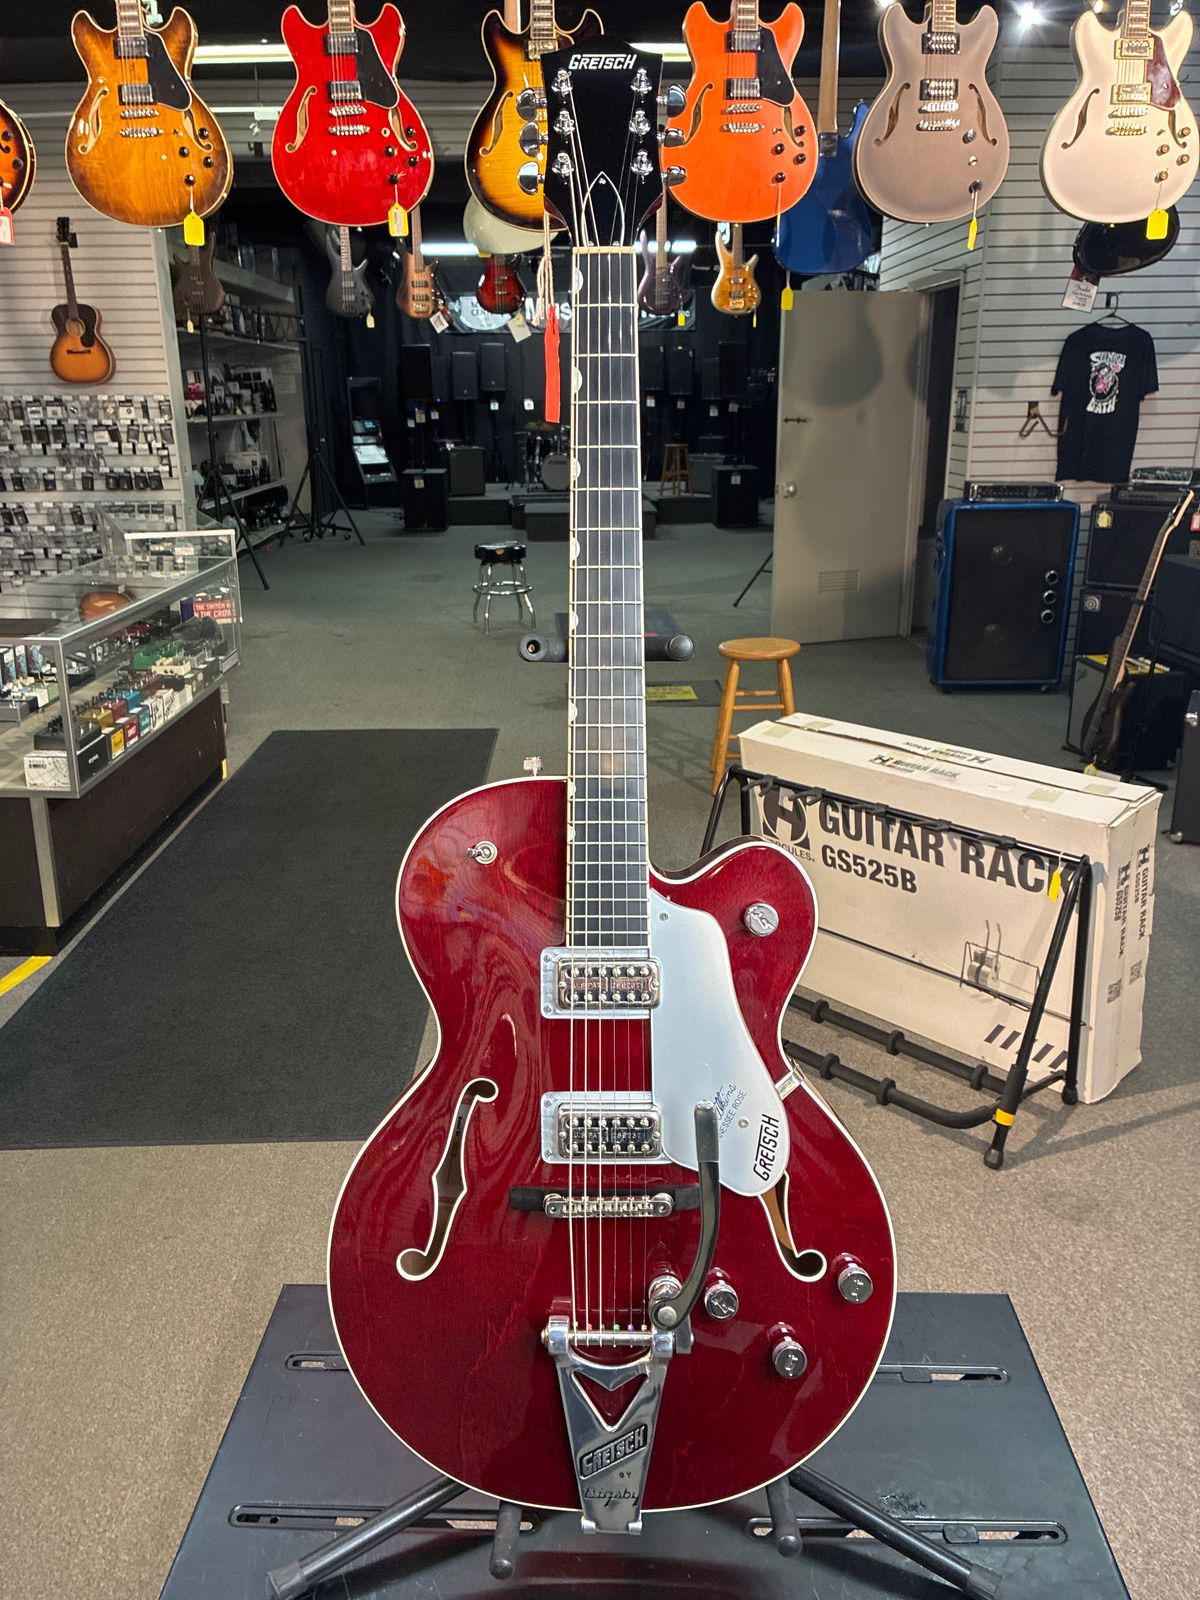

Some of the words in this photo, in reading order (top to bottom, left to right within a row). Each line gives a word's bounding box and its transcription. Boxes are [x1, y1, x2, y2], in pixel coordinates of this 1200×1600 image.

[568, 54, 638, 70] GRETSCH
[818, 800, 944, 868] GUITAR
[821, 843, 917, 894] GS525B
[1140, 867, 1149, 908] GUITAR
[731, 1090, 747, 1110] ROSE
[753, 1113, 780, 1182] GRETSCH
[581, 1424, 646, 1476] GRETSCH
[619, 1471, 632, 1479] BY
